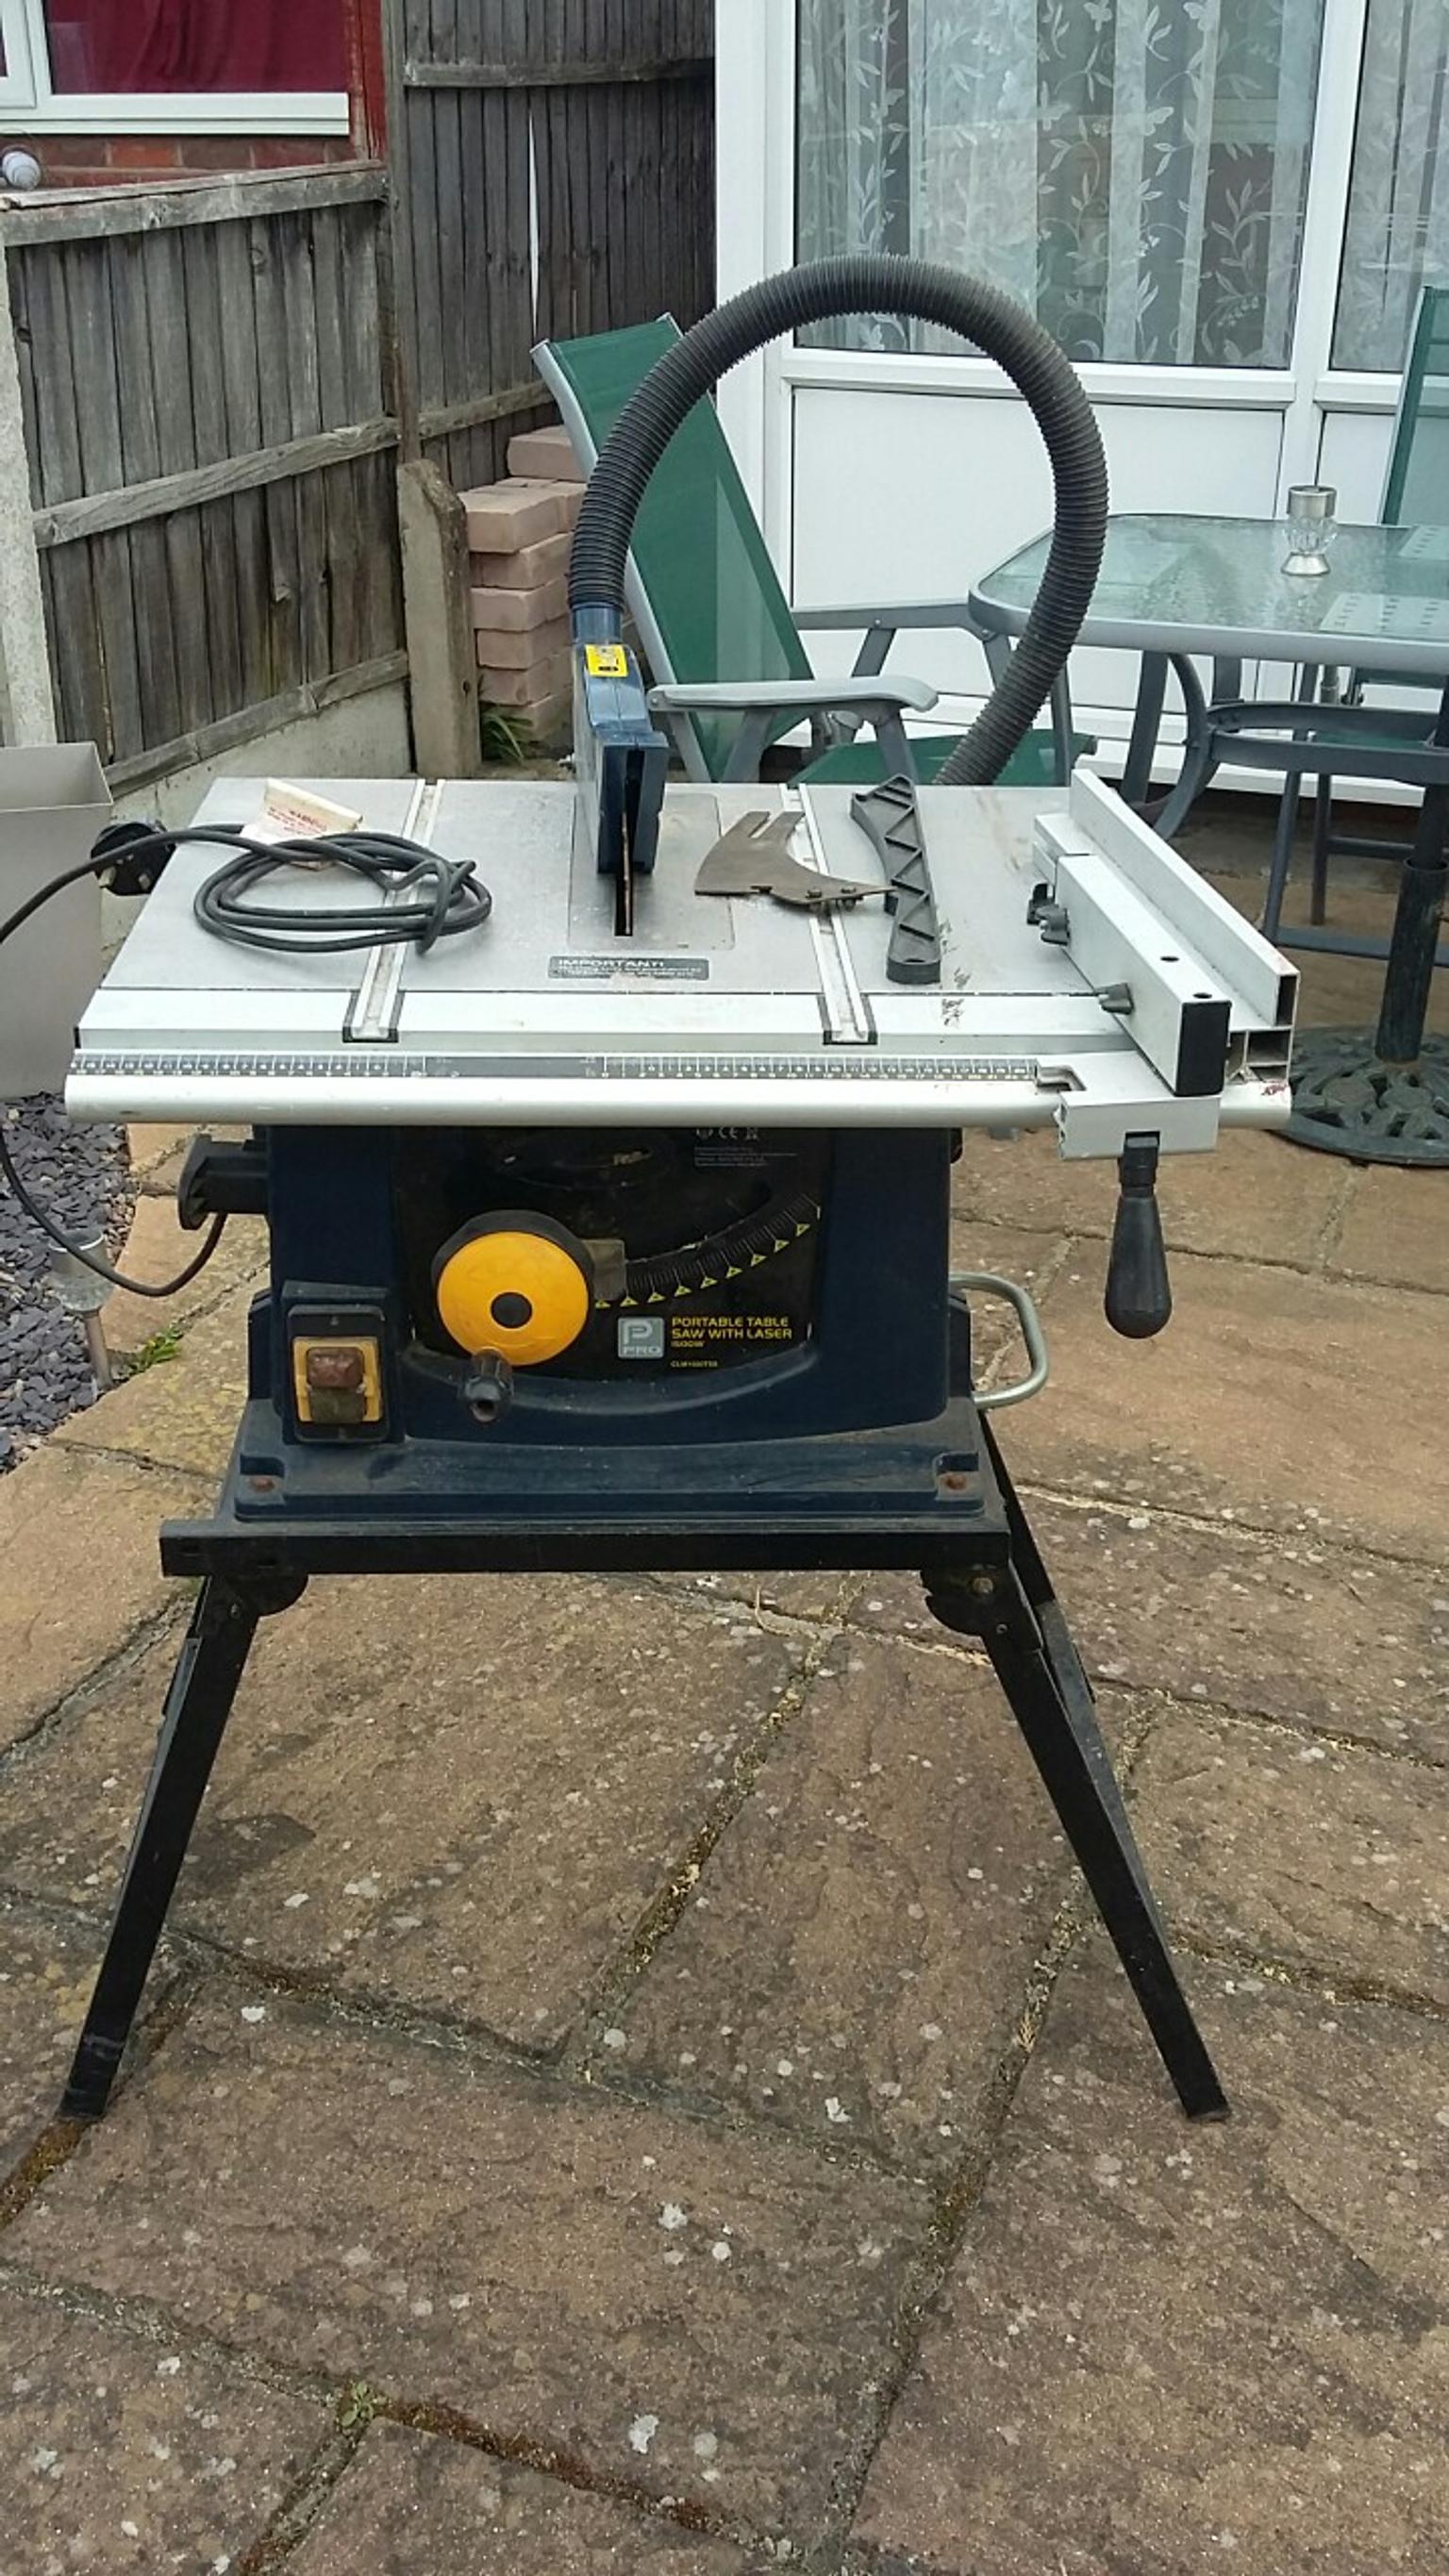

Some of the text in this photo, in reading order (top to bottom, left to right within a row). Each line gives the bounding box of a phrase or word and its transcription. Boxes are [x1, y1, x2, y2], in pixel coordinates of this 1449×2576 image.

[672, 1317, 789, 1327] PORTABLE TABLE
[672, 1328, 792, 1339] SAW WITH LASER
[623, 1346, 660, 1355] PRO
